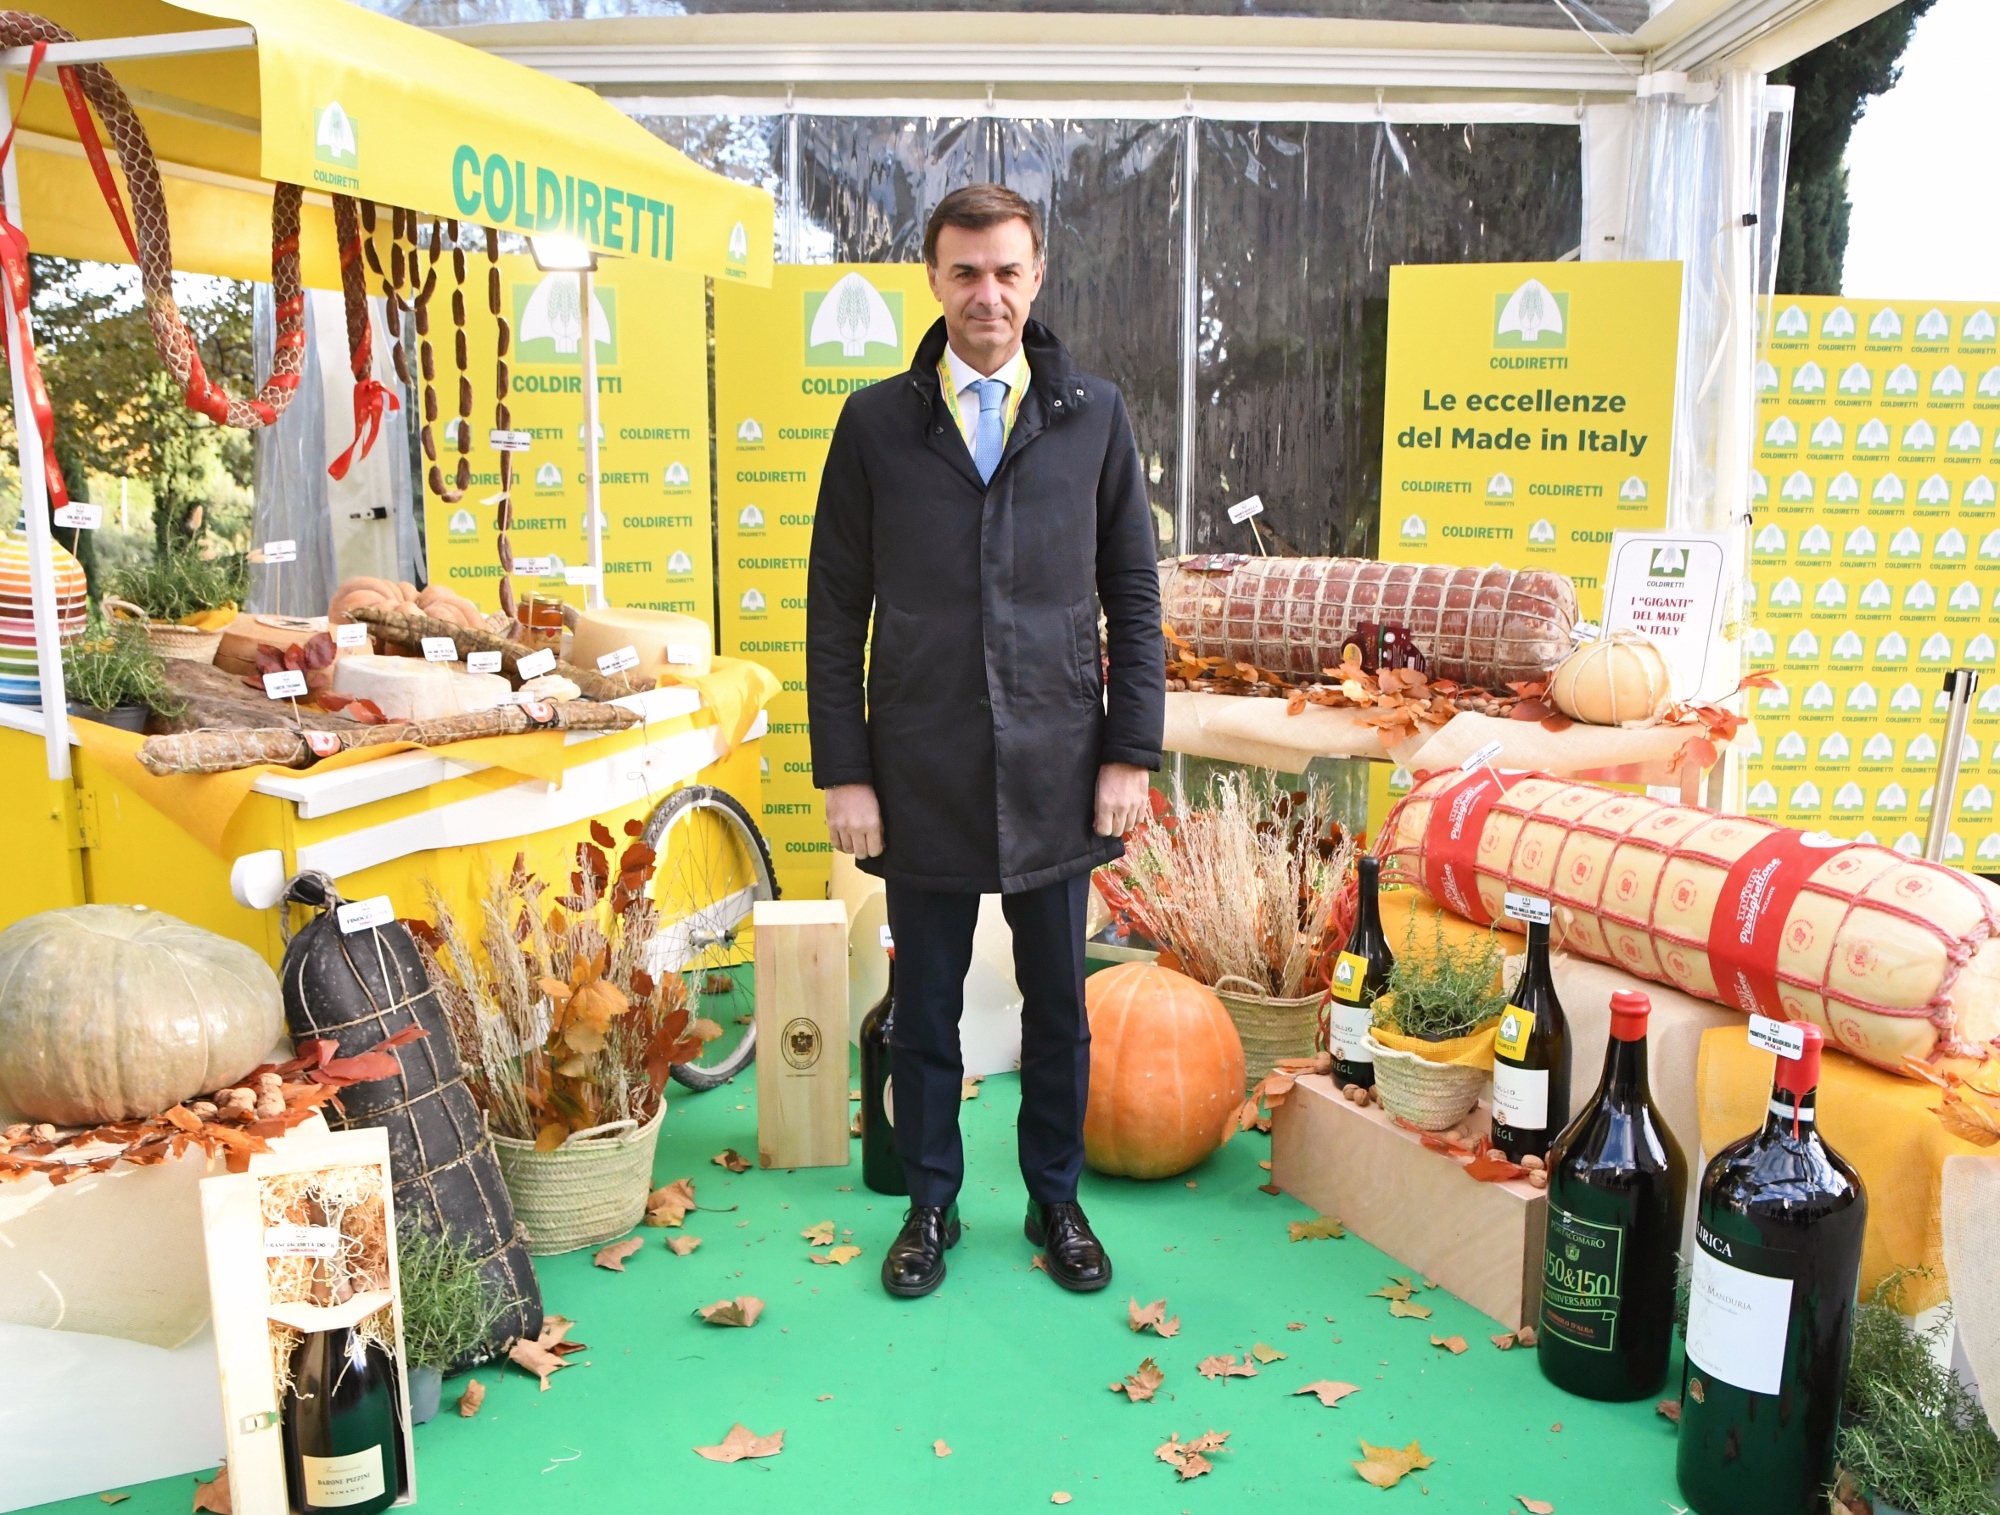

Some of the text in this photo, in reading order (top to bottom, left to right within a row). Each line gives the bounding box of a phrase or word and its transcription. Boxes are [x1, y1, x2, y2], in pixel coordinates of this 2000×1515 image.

[313, 169, 360, 190] COLDIRETTI
[452, 144, 674, 261] COLDIRETTI
[1490, 356, 1568, 370] COLDIRETTI
[512, 375, 622, 394] COLDIRTTI
[1423, 389, 1627, 413] Le eccellenze
[620, 428, 690, 440] COLDIRETTI
[1397, 426, 1648, 457] del Made in Italy
[736, 471, 806, 483] COLDIRETTI
[1401, 480, 1472, 494] COLDIRETTI
[1528, 483, 1603, 497] COLDIRETTI
[623, 516, 692, 528] COLDIRETTI
[1441, 525, 1514, 540] COLDIRETTI
[738, 558, 807, 570] COLDIRETTI
[1631, 597, 1635, 605] I
[1632, 611, 1687, 623] DEL MADE
[1650, 626, 1681, 636] ITALY
[1740, 857, 1782, 945] Pizzighettone
[1761, 886, 1776, 915] PICCANTE
[1764, 1041, 1782, 1051] PUGLIA
[1551, 1220, 1606, 1249] PORTACOMARO
[1545, 1249, 1611, 1296] 150&150
[1545, 1288, 1602, 1307] ANNIVERSARIO
[346, 1472, 371, 1484] PIZZINI
[325, 1486, 365, 1495] ANIMANTE
